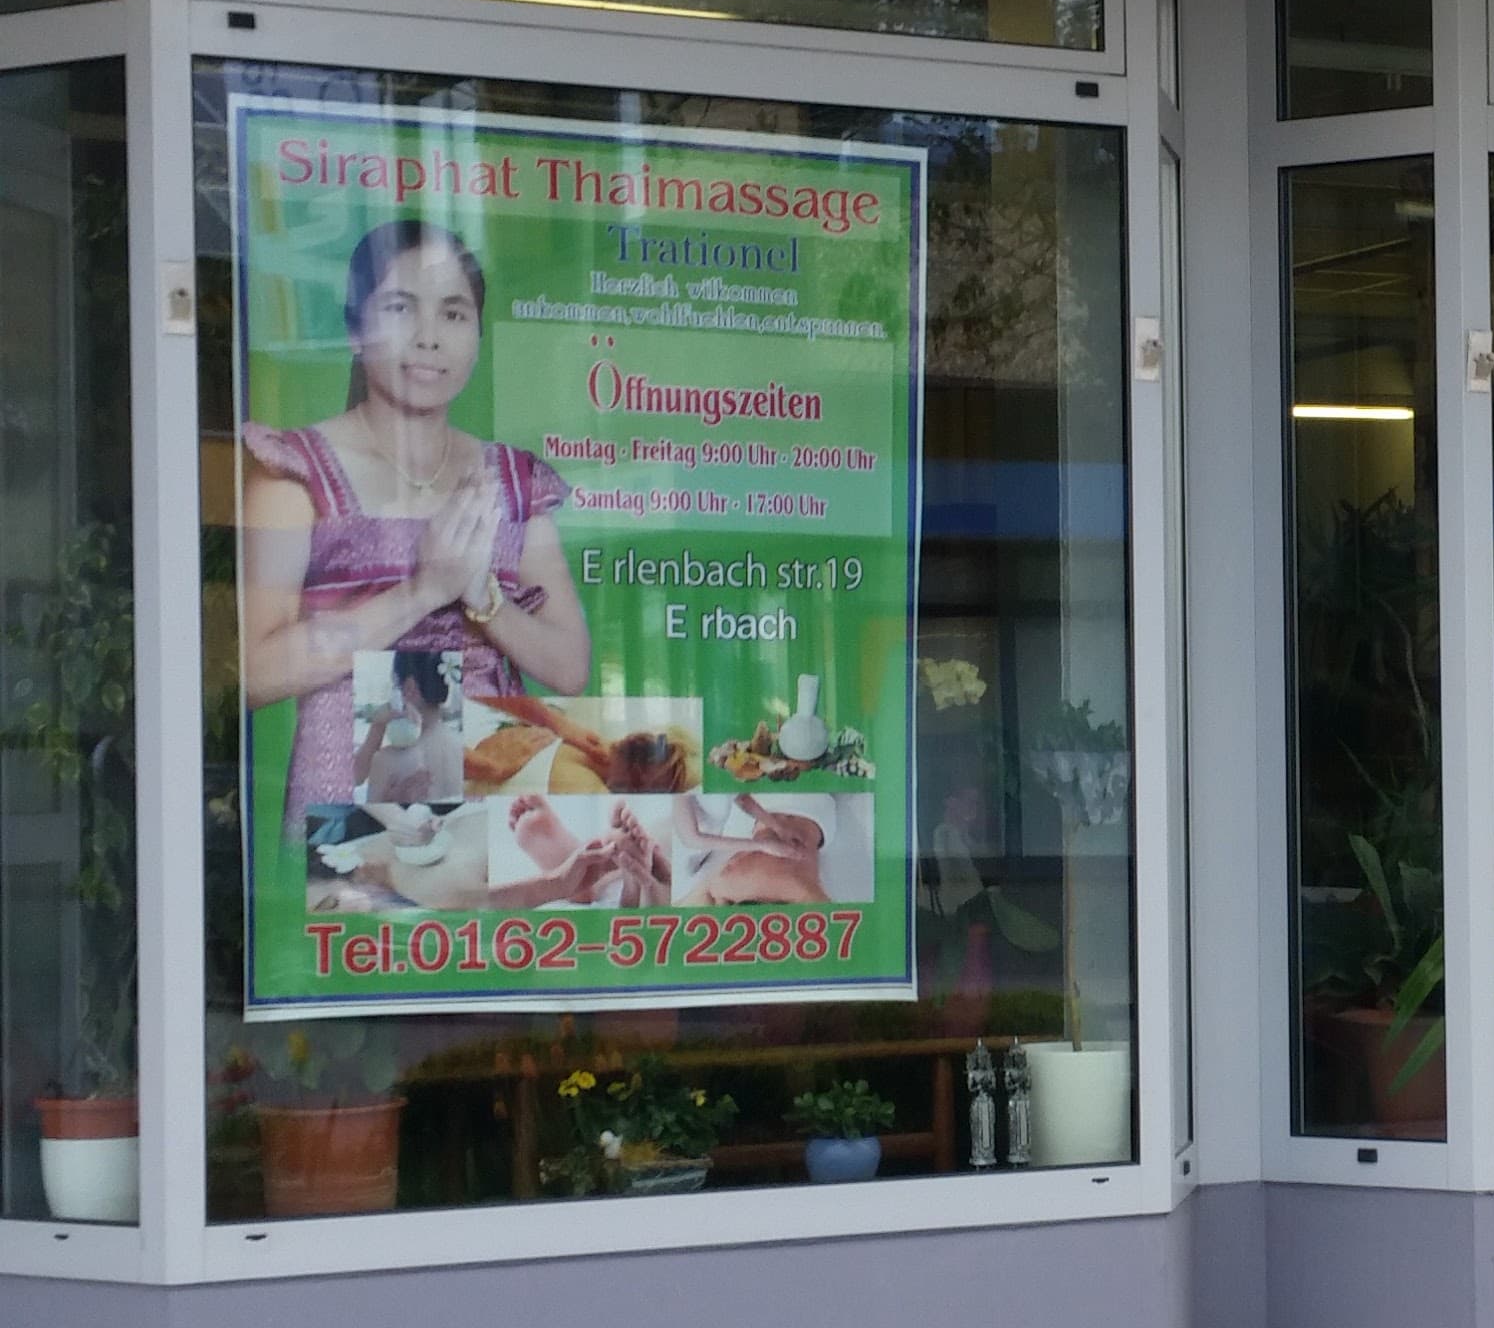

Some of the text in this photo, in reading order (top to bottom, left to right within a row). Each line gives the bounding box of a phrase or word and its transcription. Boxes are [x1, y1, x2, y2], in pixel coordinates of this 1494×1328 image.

[277, 137, 881, 233] Siraphat Thaimassage
[588, 334, 823, 426] Öffnungszeiten
[545, 434, 617, 466] Montag
[632, 438, 697, 469] Freitag
[701, 441, 743, 466] 9:00
[748, 443, 777, 467] Uhr
[791, 446, 841, 469] 20:00
[846, 448, 877, 471] Uhr
[573, 486, 644, 517] Samtag
[650, 490, 692, 513] 9:00
[697, 491, 728, 515] Uhr
[746, 493, 794, 515] 17:00
[799, 494, 828, 518] Uhr
